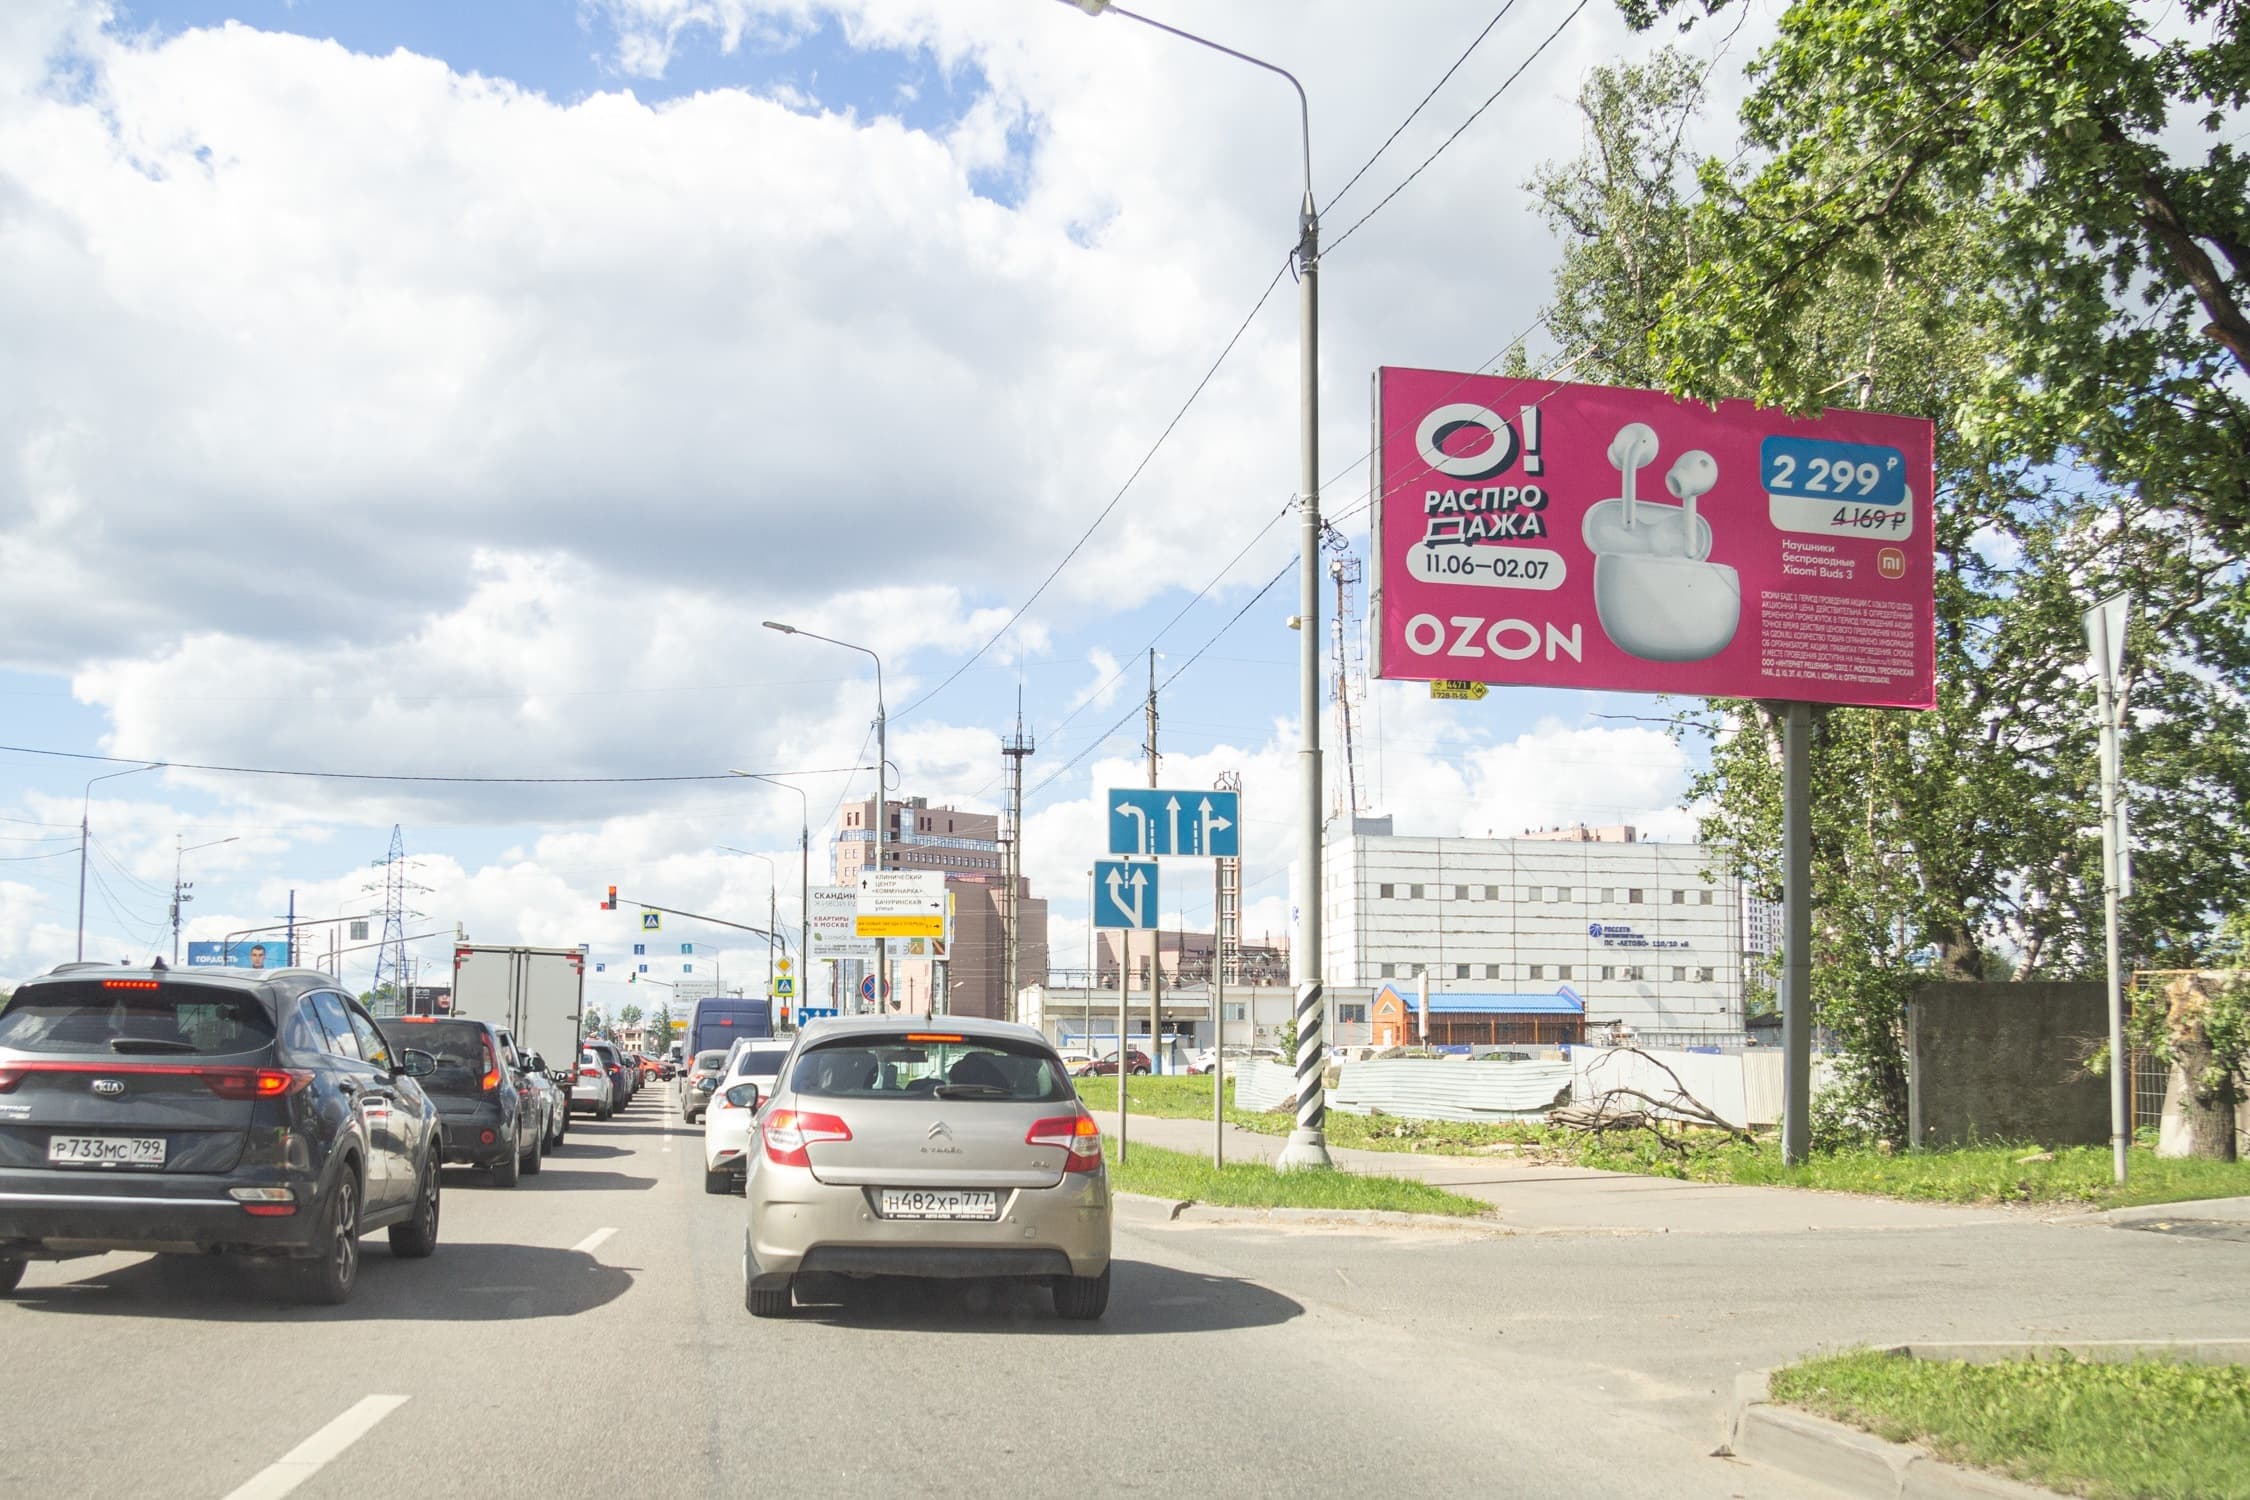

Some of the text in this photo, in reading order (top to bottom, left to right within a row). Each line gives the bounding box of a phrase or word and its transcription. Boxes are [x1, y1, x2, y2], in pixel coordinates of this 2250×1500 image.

[1415, 403, 1543, 478] О!
[1769, 454, 1796, 489] 2
[1805, 458, 1880, 496] 299
[1424, 485, 1545, 515] РАСПРО
[1422, 512, 1543, 547] ДАЖА
[1782, 539, 1836, 553] Наушники
[1782, 552, 1856, 568] беспроводные
[1783, 565, 1853, 580] Xiaomi Buds 3
[1404, 613, 1583, 664] OZON
[98, 1082, 119, 1092] KIA
[133, 1140, 161, 1155] 799
[963, 1192, 990, 1206] 777
